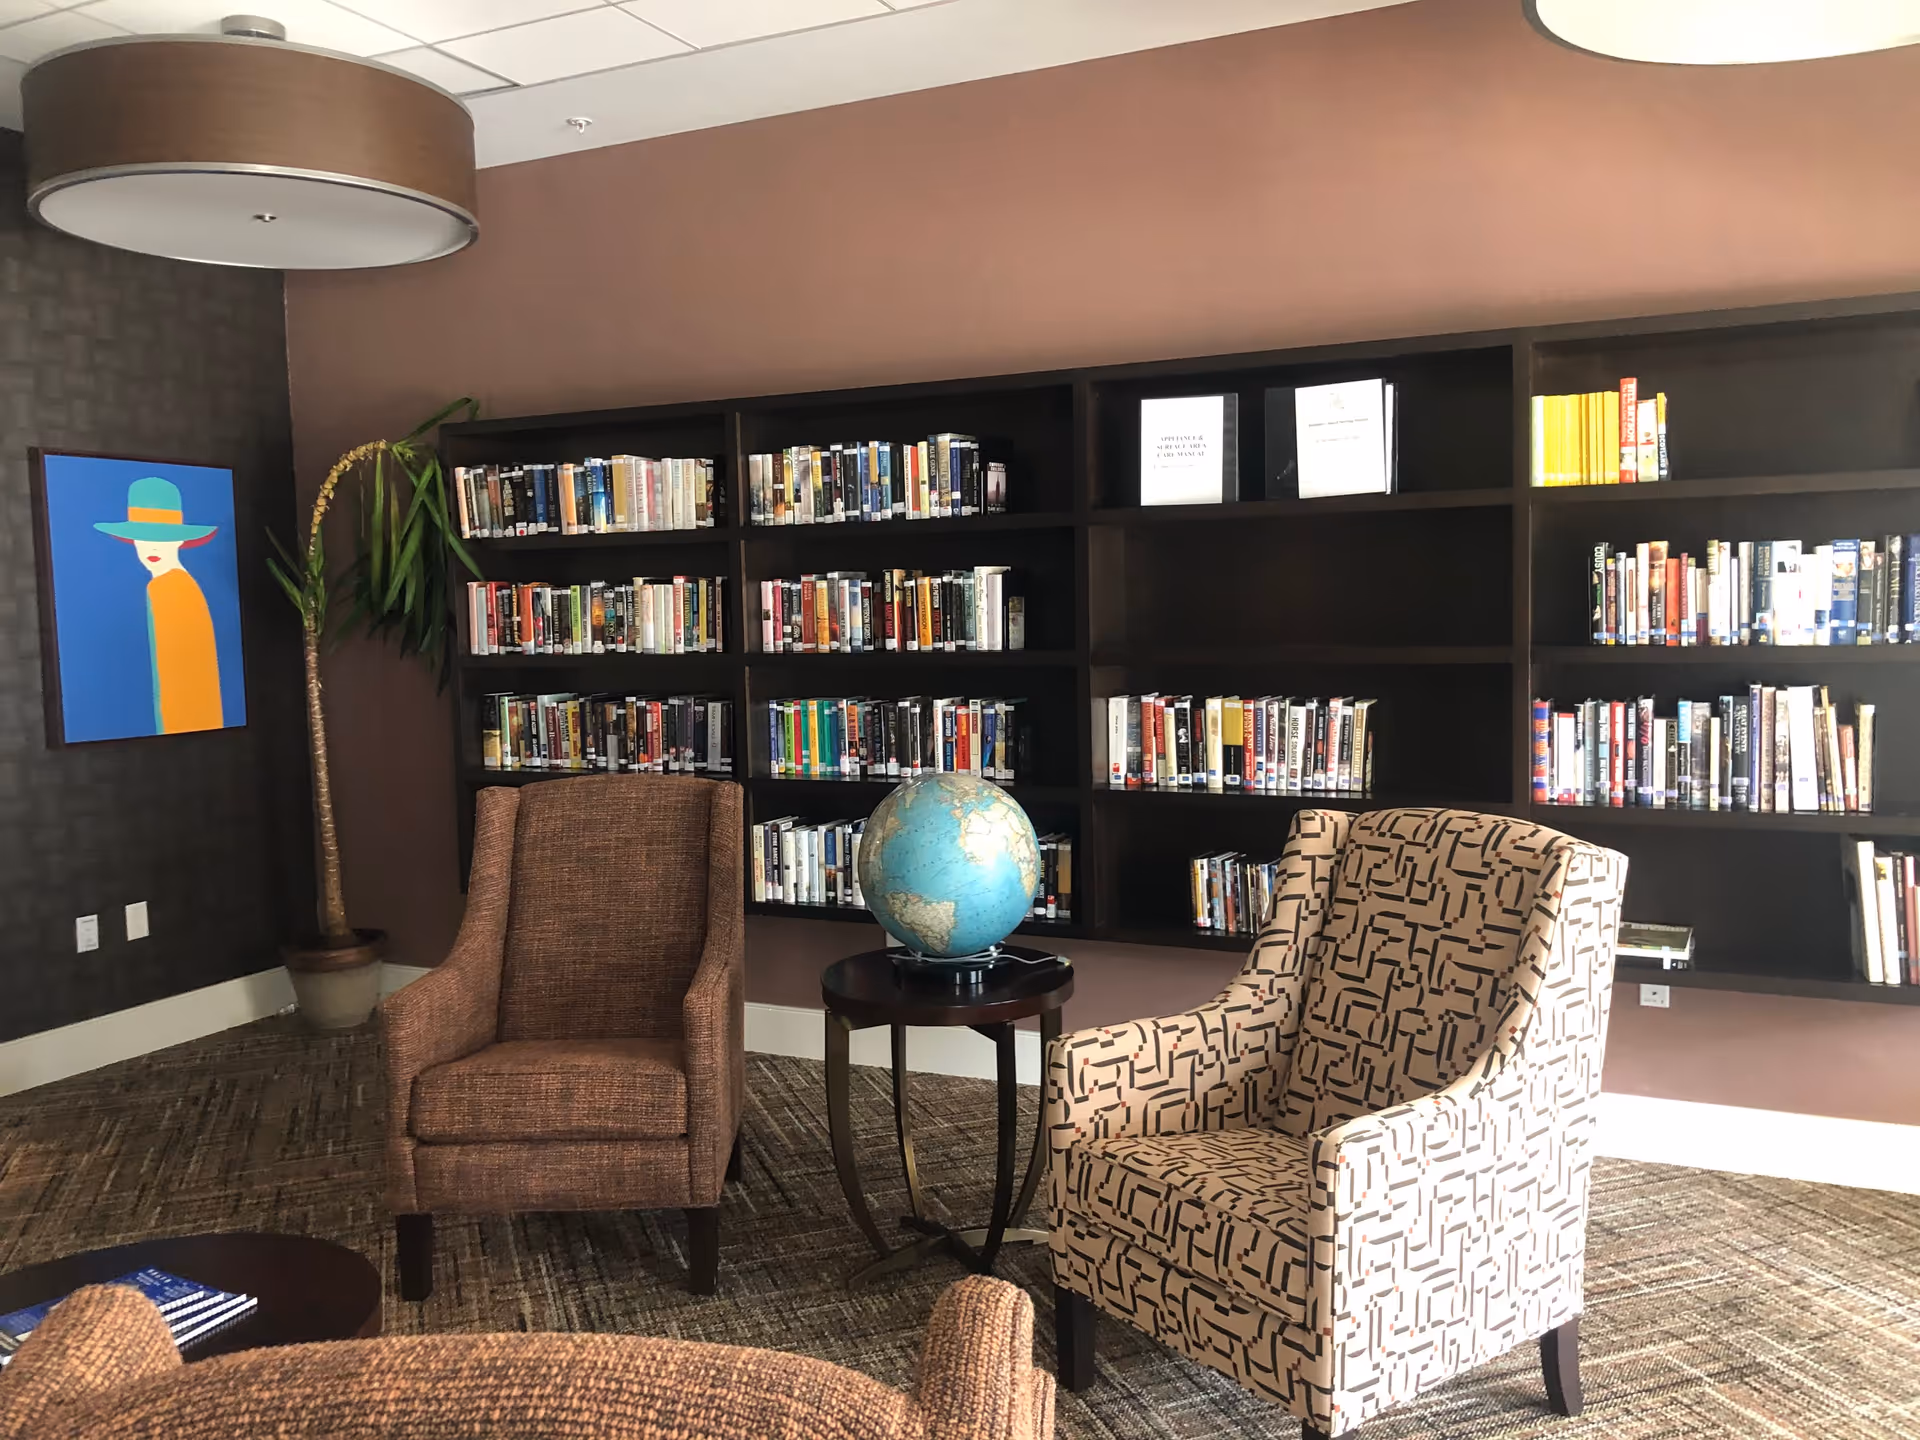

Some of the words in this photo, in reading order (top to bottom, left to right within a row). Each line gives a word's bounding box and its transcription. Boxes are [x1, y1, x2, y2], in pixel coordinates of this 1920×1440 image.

[1659, 433, 1667, 468] SCOTLAND
[1594, 546, 1604, 573] COUSY
[1291, 717, 1299, 739] HORSE
[1290, 741, 1298, 766] SOLDIERS
